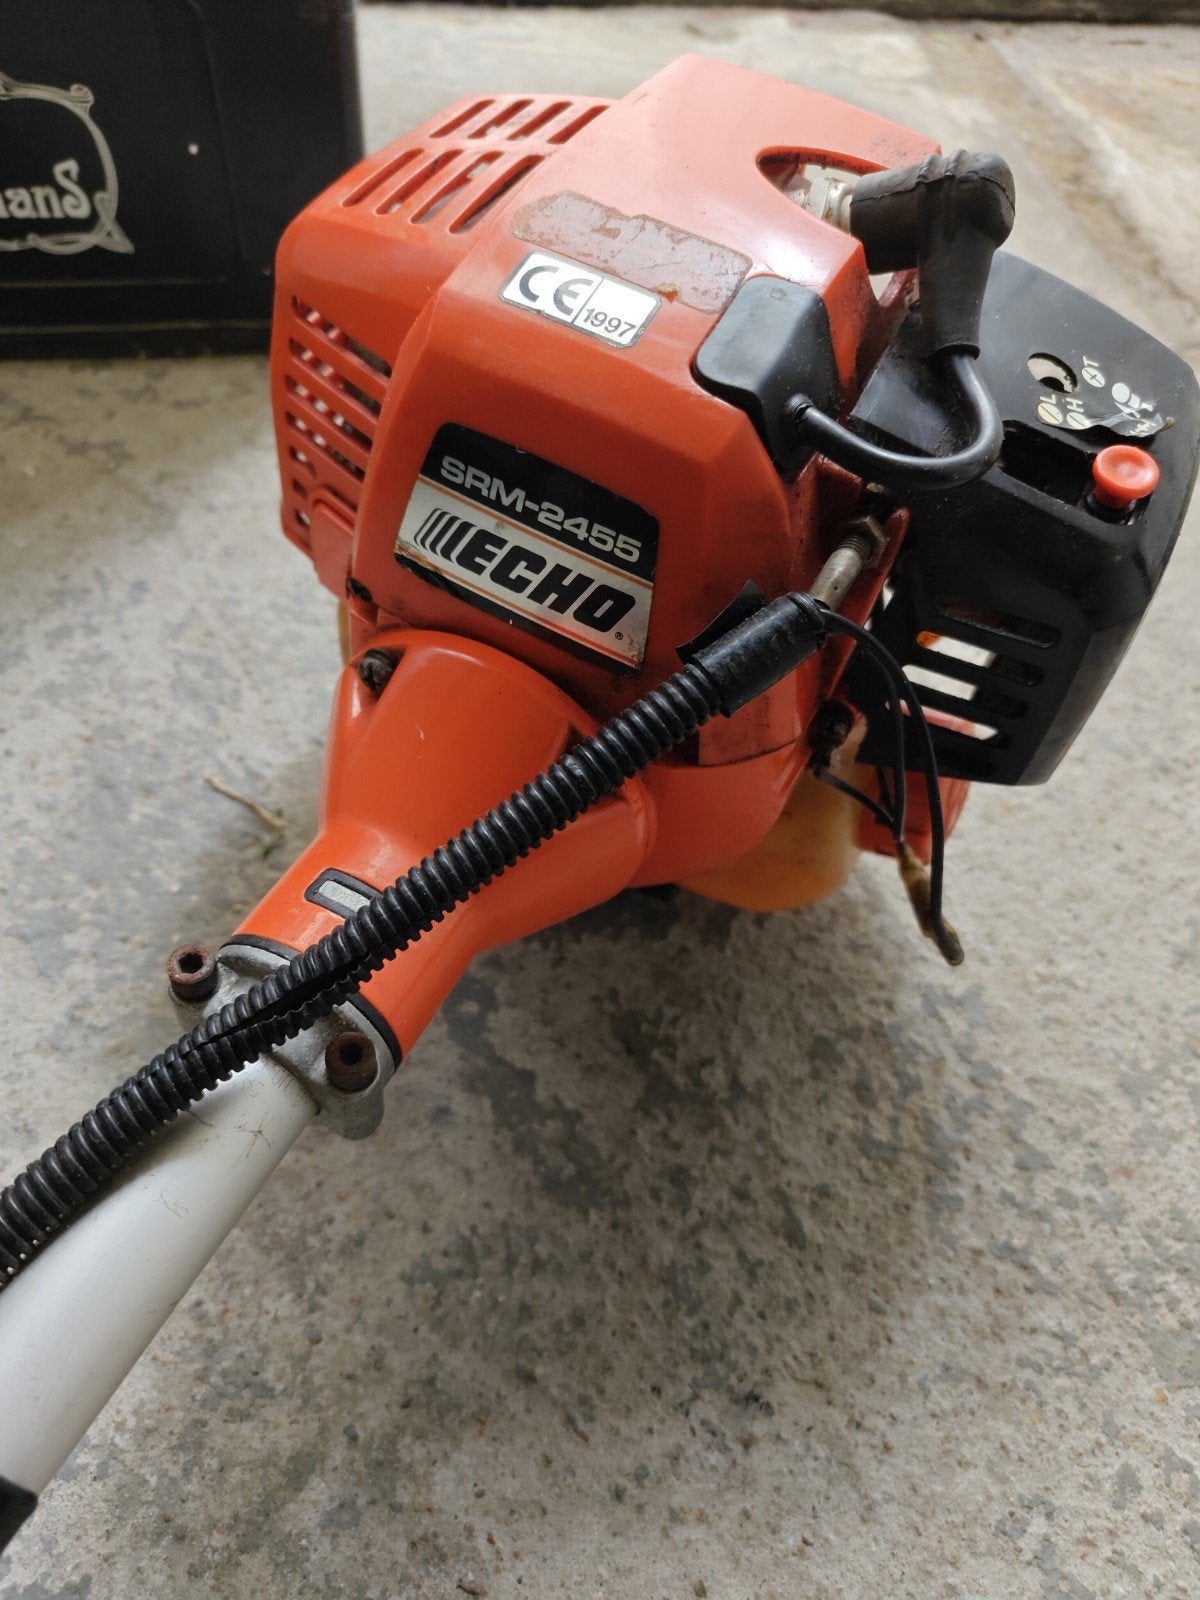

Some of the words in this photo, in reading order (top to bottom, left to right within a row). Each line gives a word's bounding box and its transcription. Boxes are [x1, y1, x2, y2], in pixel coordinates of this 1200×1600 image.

[519, 265, 594, 316] CE
[583, 308, 637, 338] 1997
[1040, 394, 1056, 405] L
[1066, 397, 1084, 412] H
[440, 455, 642, 563] SRM-2455
[455, 528, 636, 633] ECHO
